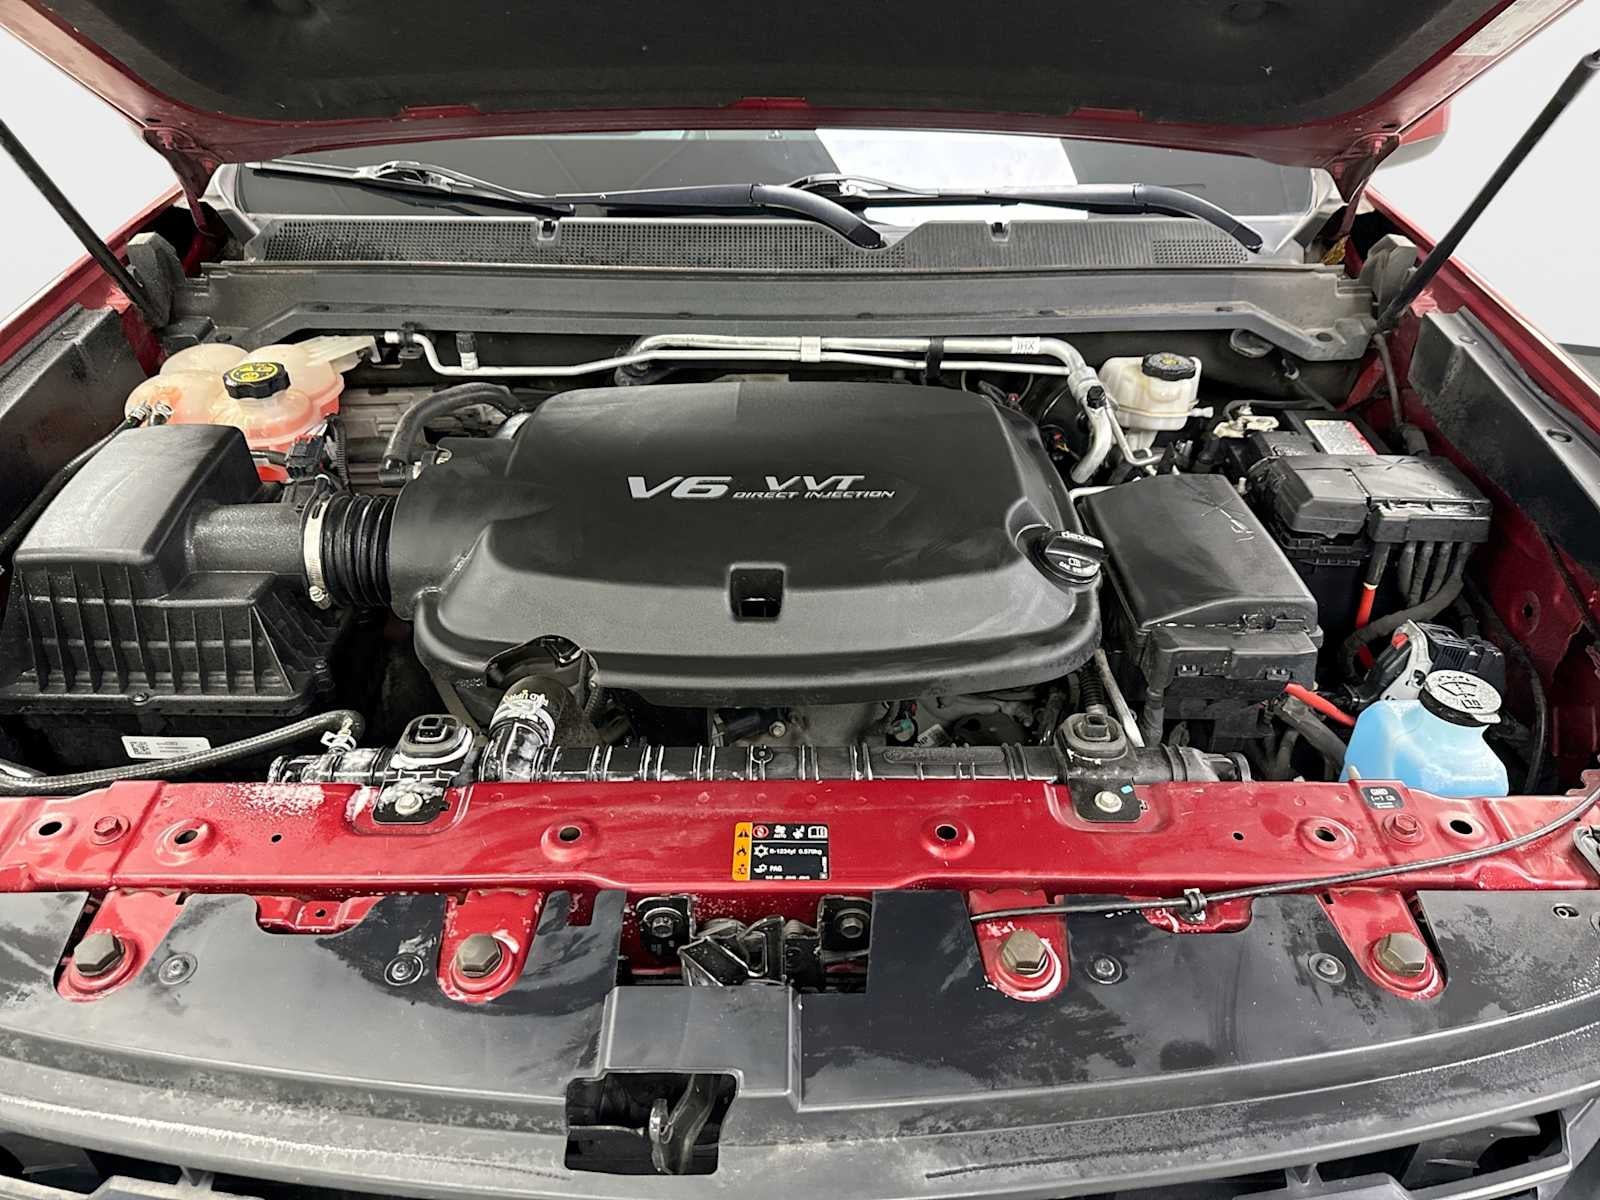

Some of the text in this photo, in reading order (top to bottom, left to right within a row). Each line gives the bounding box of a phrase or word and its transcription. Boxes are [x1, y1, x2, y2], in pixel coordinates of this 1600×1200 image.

[627, 475, 865, 499] V6 VVT
[732, 490, 895, 499] DIRECT INJECTION
